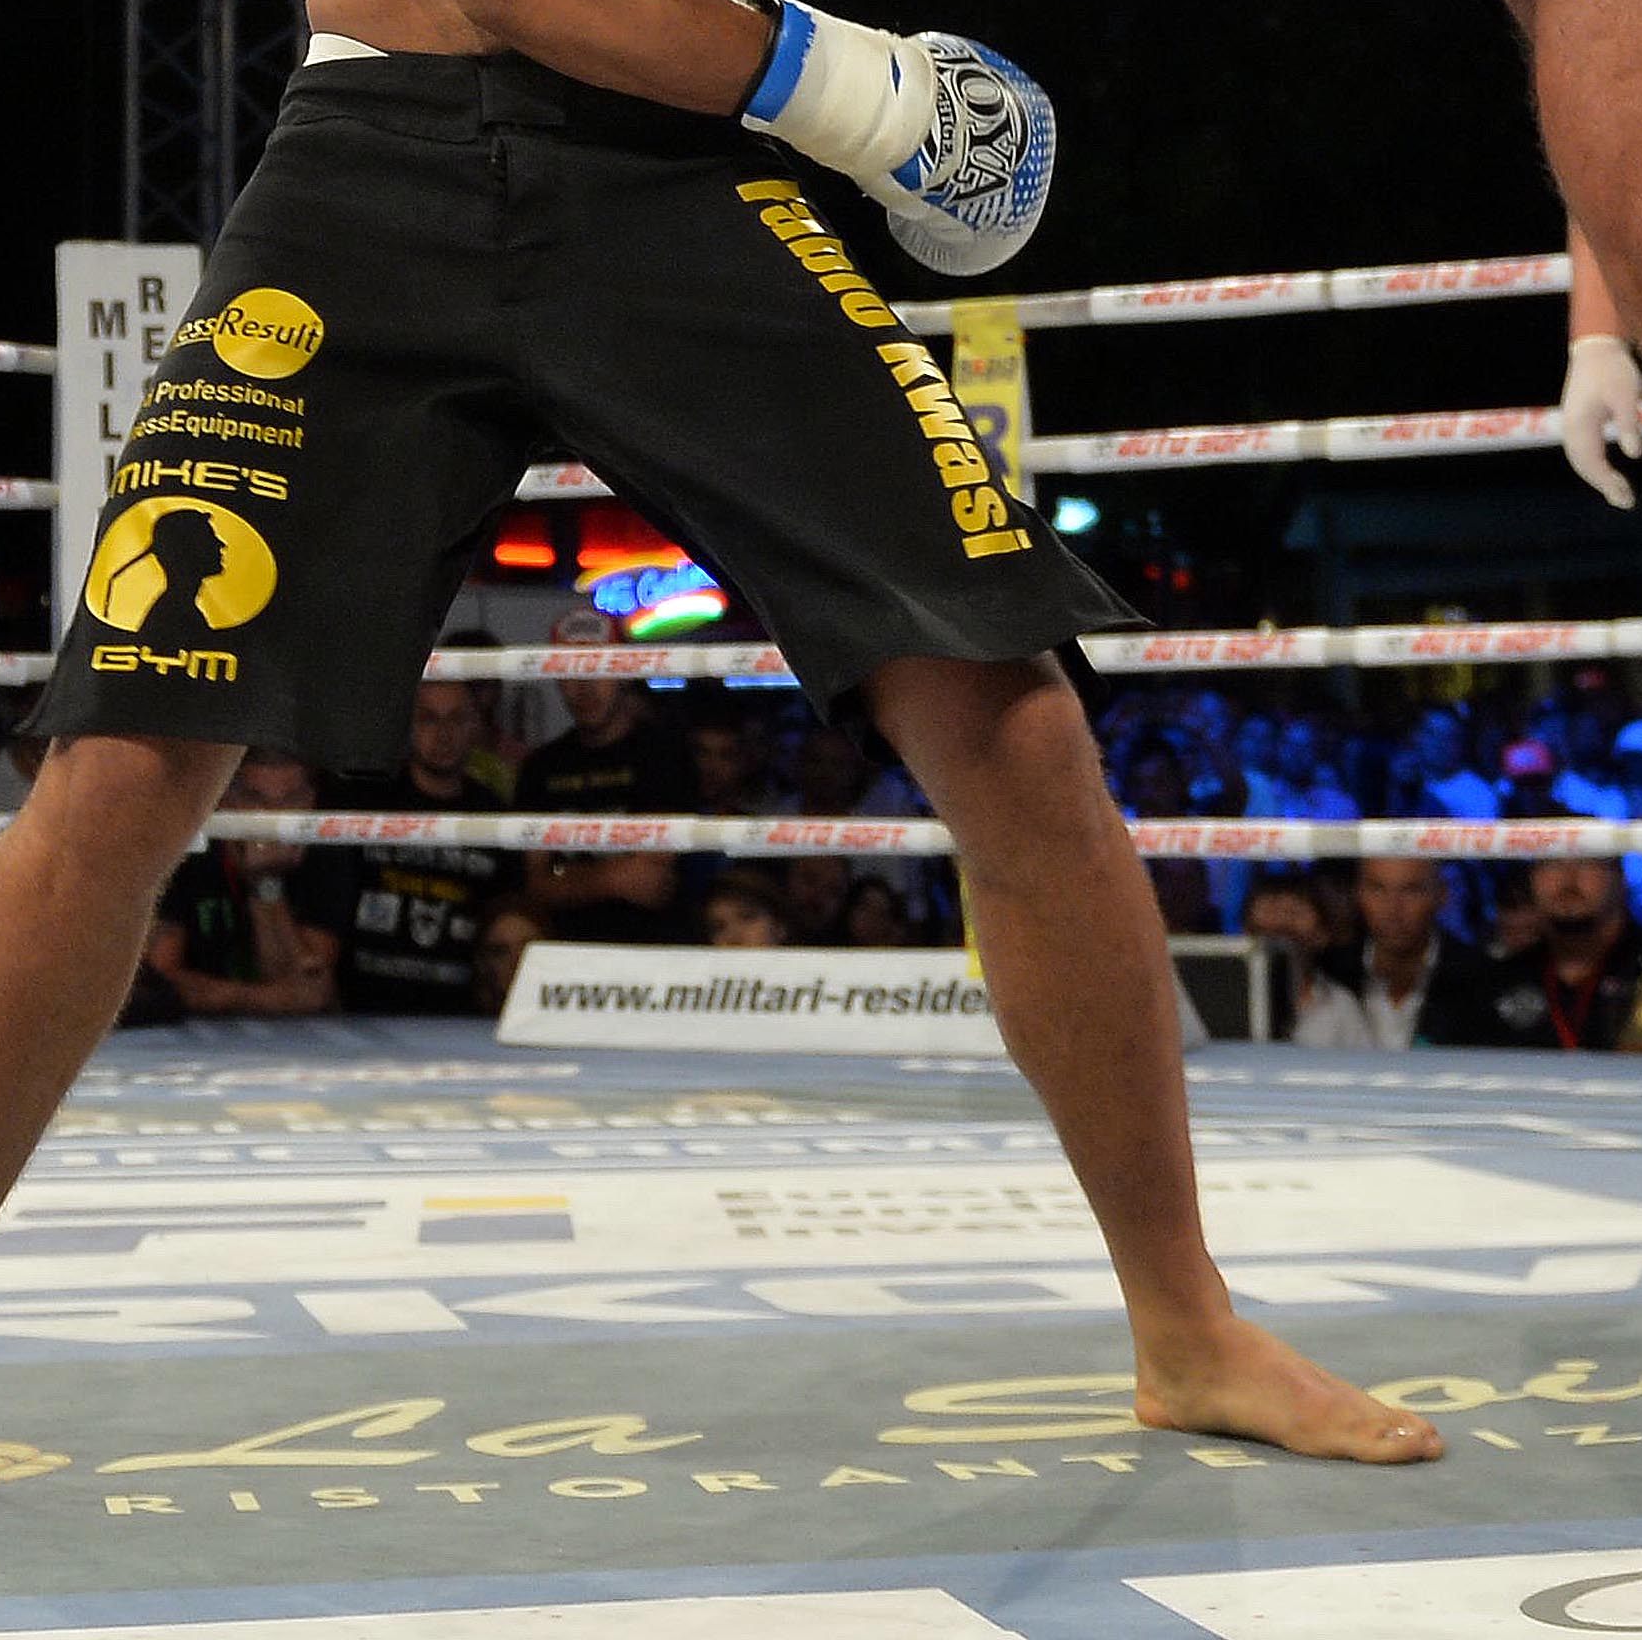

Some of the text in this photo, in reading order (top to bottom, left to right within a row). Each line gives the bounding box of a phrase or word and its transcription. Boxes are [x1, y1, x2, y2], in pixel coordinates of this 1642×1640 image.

[219, 306, 321, 354] Result
[108, 459, 288, 501] MIKE'S
[91, 644, 238, 682] GYM
[539, 974, 993, 1015] www.militari-reside
[96, 1396, 704, 1475] La
[104, 1448, 1266, 1517] RISTORANTE
